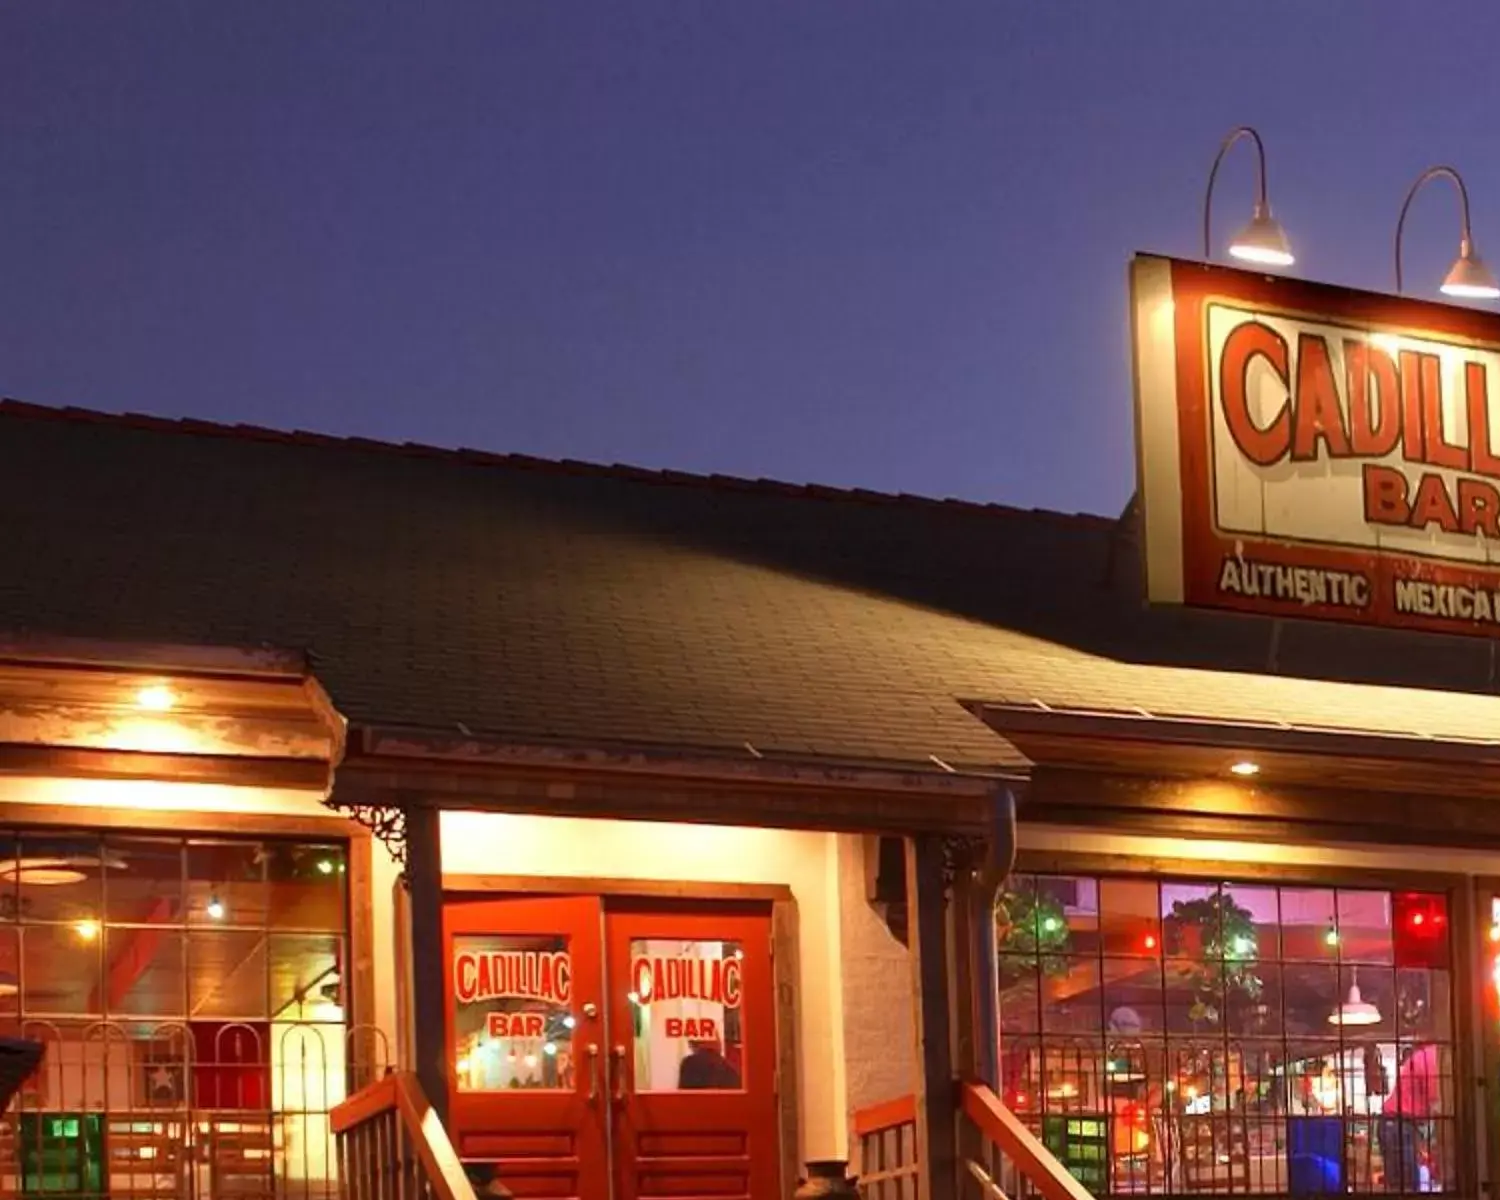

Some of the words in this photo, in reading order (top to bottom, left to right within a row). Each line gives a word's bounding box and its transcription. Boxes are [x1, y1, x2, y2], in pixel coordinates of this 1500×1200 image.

[1219, 557, 1369, 607] AUTHENTIC
[455, 951, 572, 1004] CADILLAC
[631, 955, 743, 1007] CADILLAC
[488, 1012, 545, 1039] BAR
[664, 1016, 717, 1041] BAR
